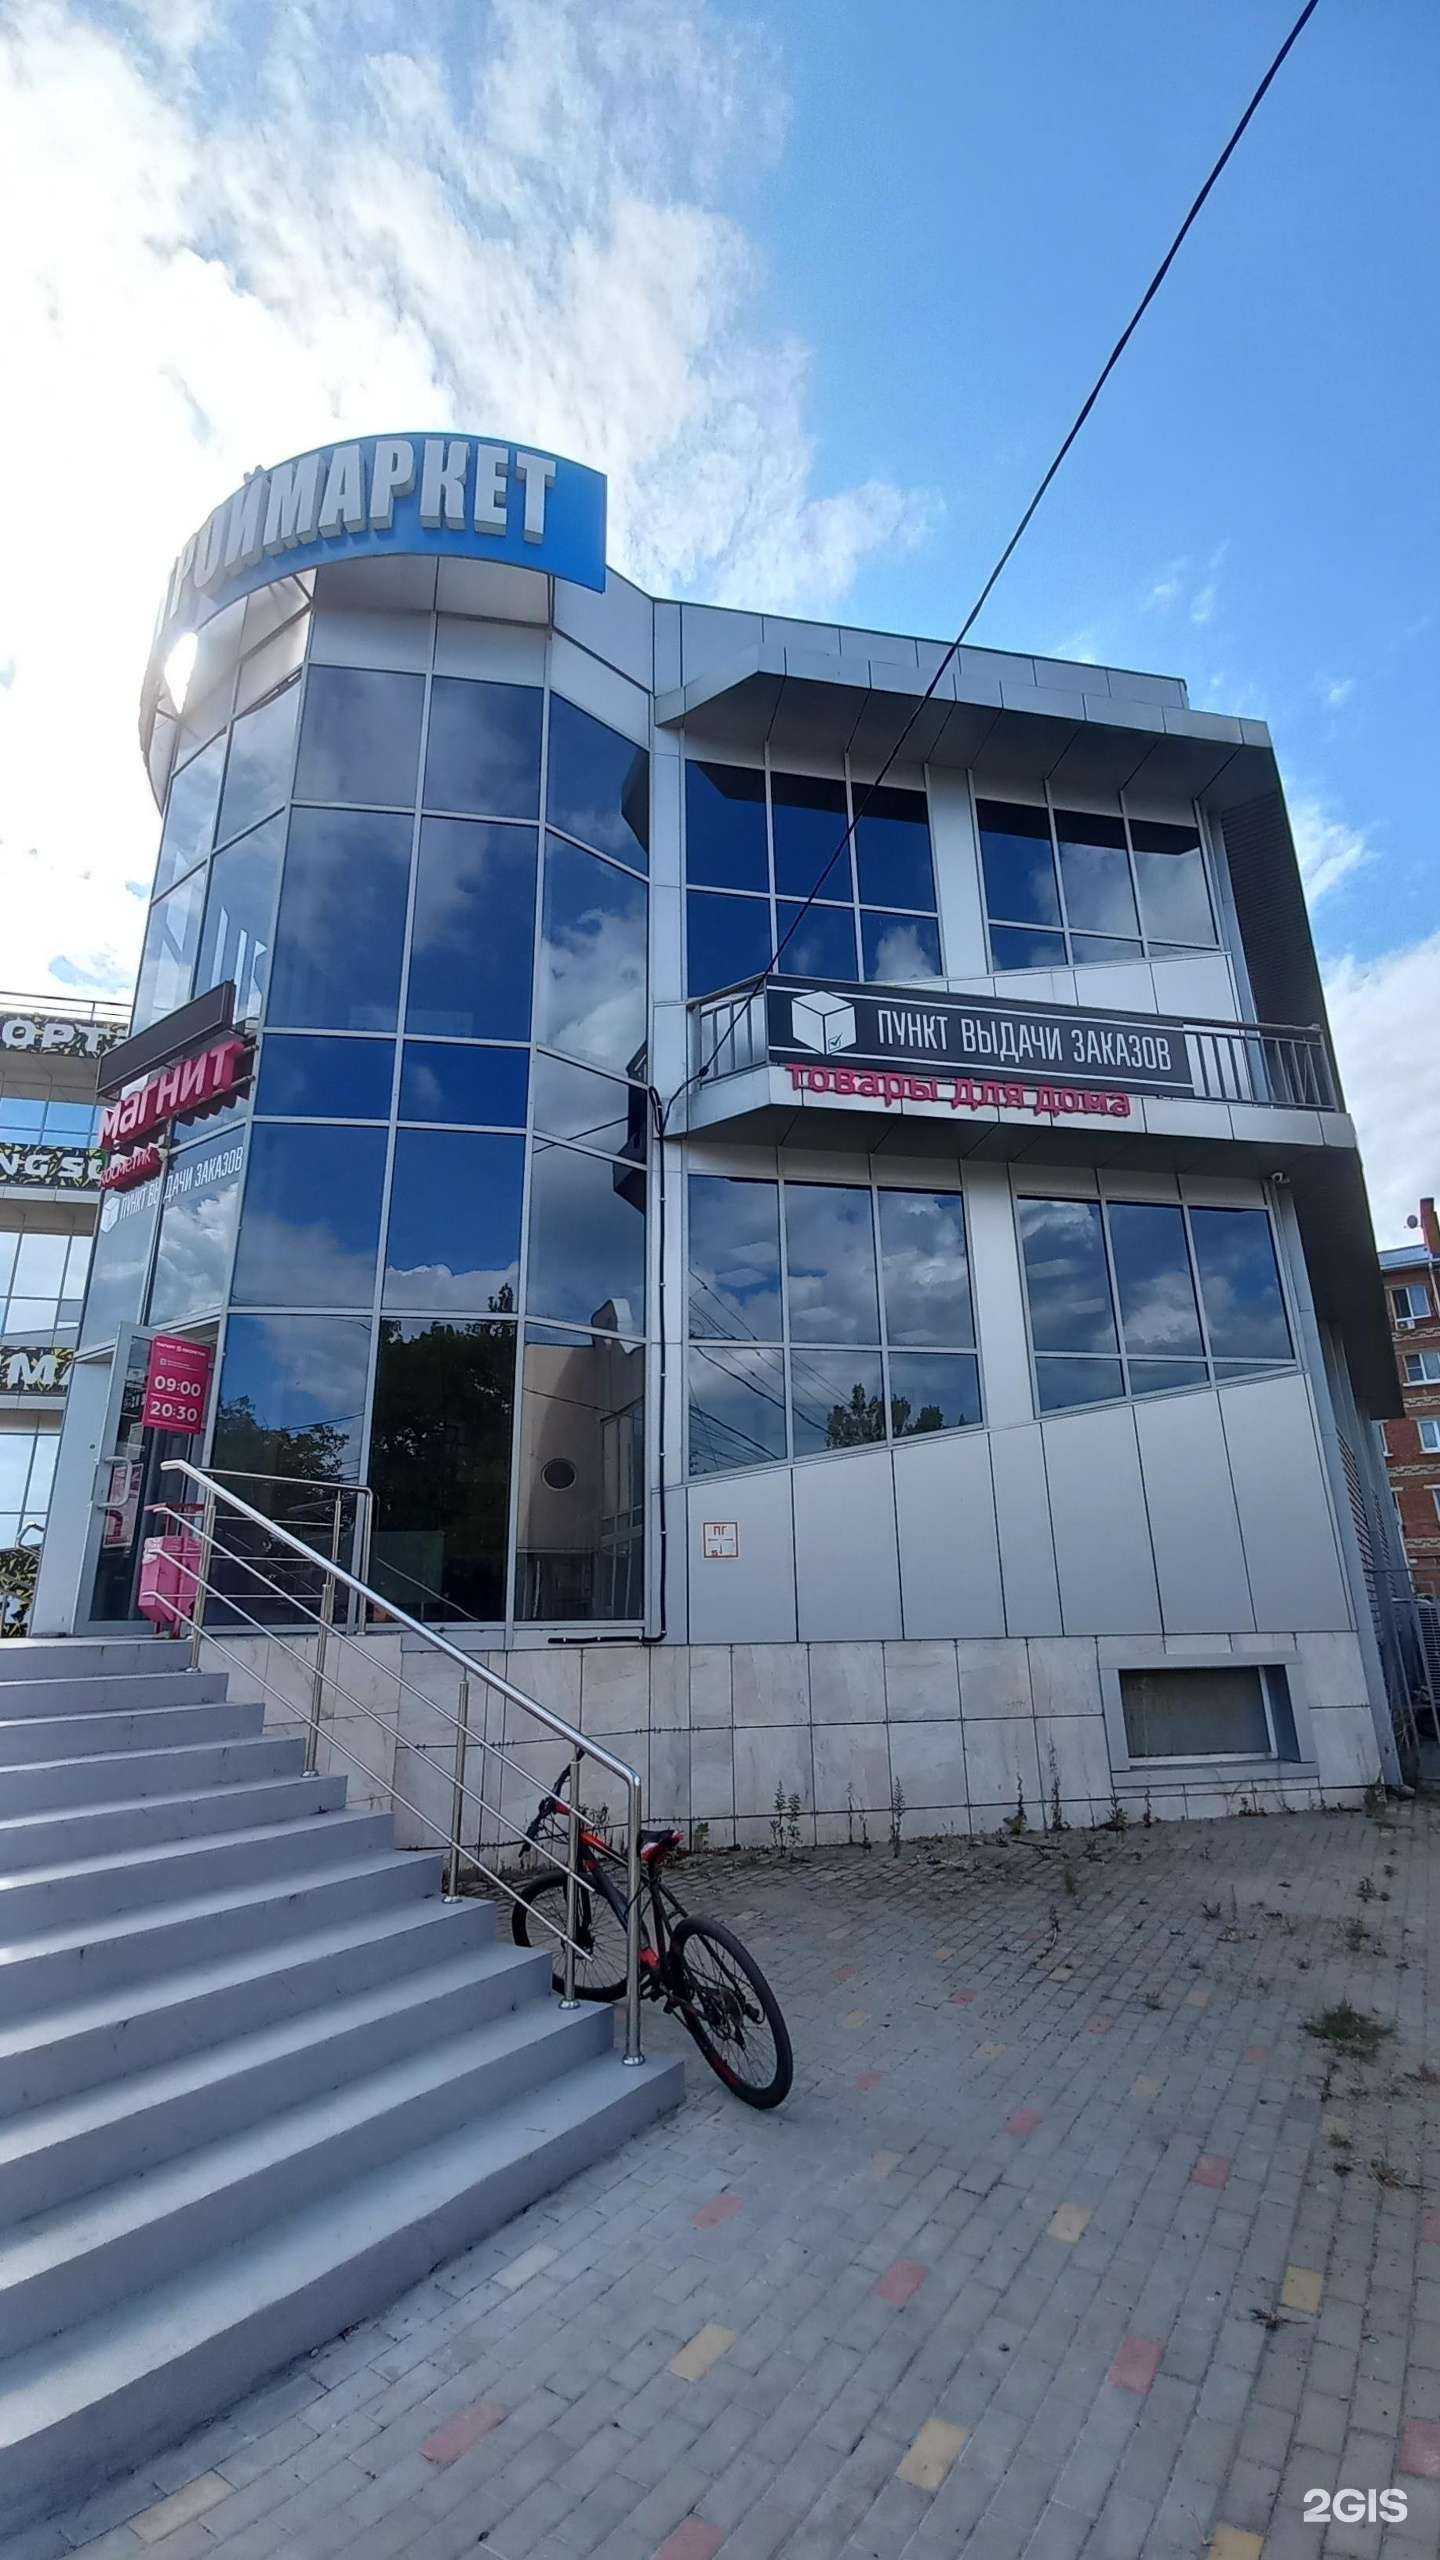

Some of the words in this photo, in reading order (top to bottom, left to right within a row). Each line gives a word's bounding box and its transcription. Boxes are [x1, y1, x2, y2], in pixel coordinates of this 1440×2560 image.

[157, 438, 557, 630] РОЙМАРКЕТ
[877, 1009, 948, 1050] ПУНКТ
[960, 1018, 1063, 1063] ВЫДАЧИ
[1071, 1029, 1172, 1071] ЗАКАЗОВ
[785, 1064, 938, 1107] товары
[950, 1077, 1024, 1111] для
[1033, 1083, 1131, 1118] дома
[194, 1146, 244, 1188] ЗАКАЗОВ
[154, 1375, 201, 1397] 09:00
[149, 1400, 198, 1422] 20:30
